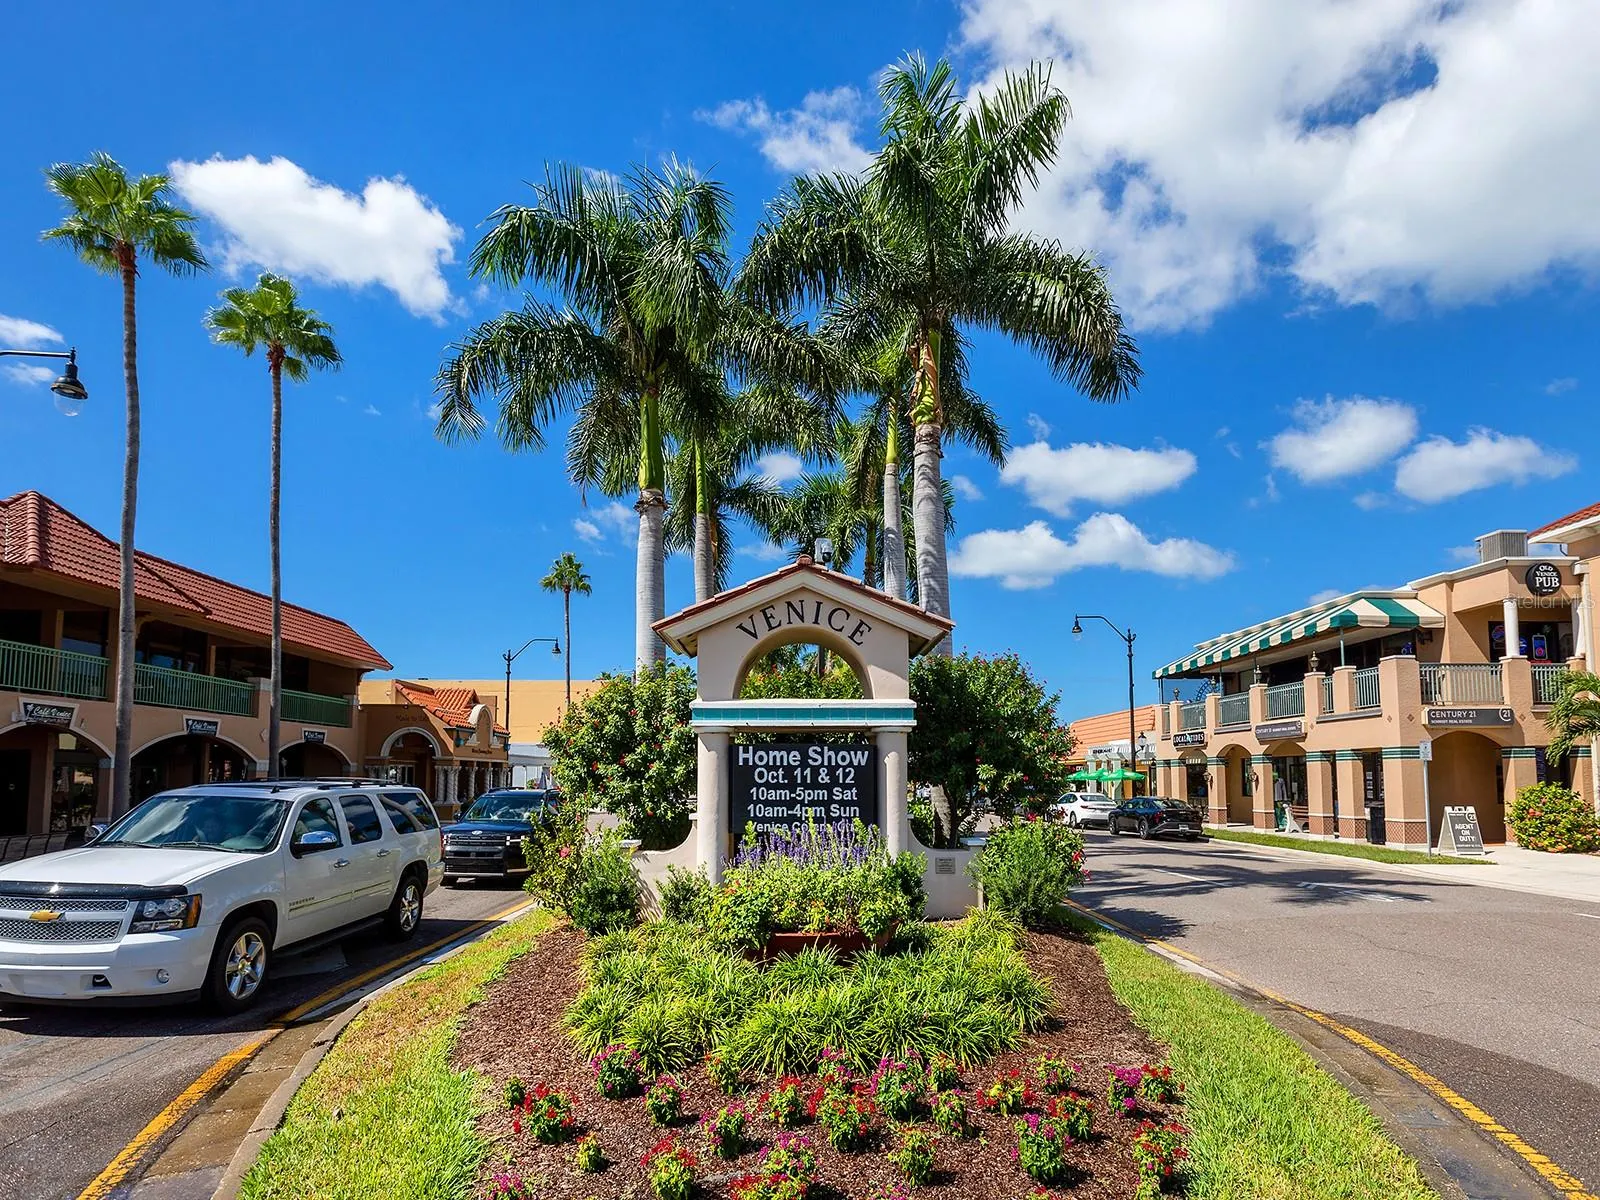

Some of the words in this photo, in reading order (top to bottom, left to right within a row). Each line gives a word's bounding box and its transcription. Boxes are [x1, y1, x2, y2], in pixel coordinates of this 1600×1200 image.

[1535, 577, 1560, 589] PUB
[735, 599, 873, 647] VENICE
[1430, 710, 1467, 718] CENTURY
[1469, 710, 1476, 718] 21
[1502, 710, 1511, 718] 21
[738, 746, 800, 766] Home
[808, 746, 869, 766] Show
[754, 767, 789, 784] Oct.
[794, 767, 811, 784] 11
[818, 767, 831, 784] &
[836, 767, 855, 784] 12
[750, 787, 828, 804] 10am-5pm
[832, 787, 858, 801] Sat
[747, 803, 825, 821] 10am-4pm
[829, 803, 860, 818] Sun
